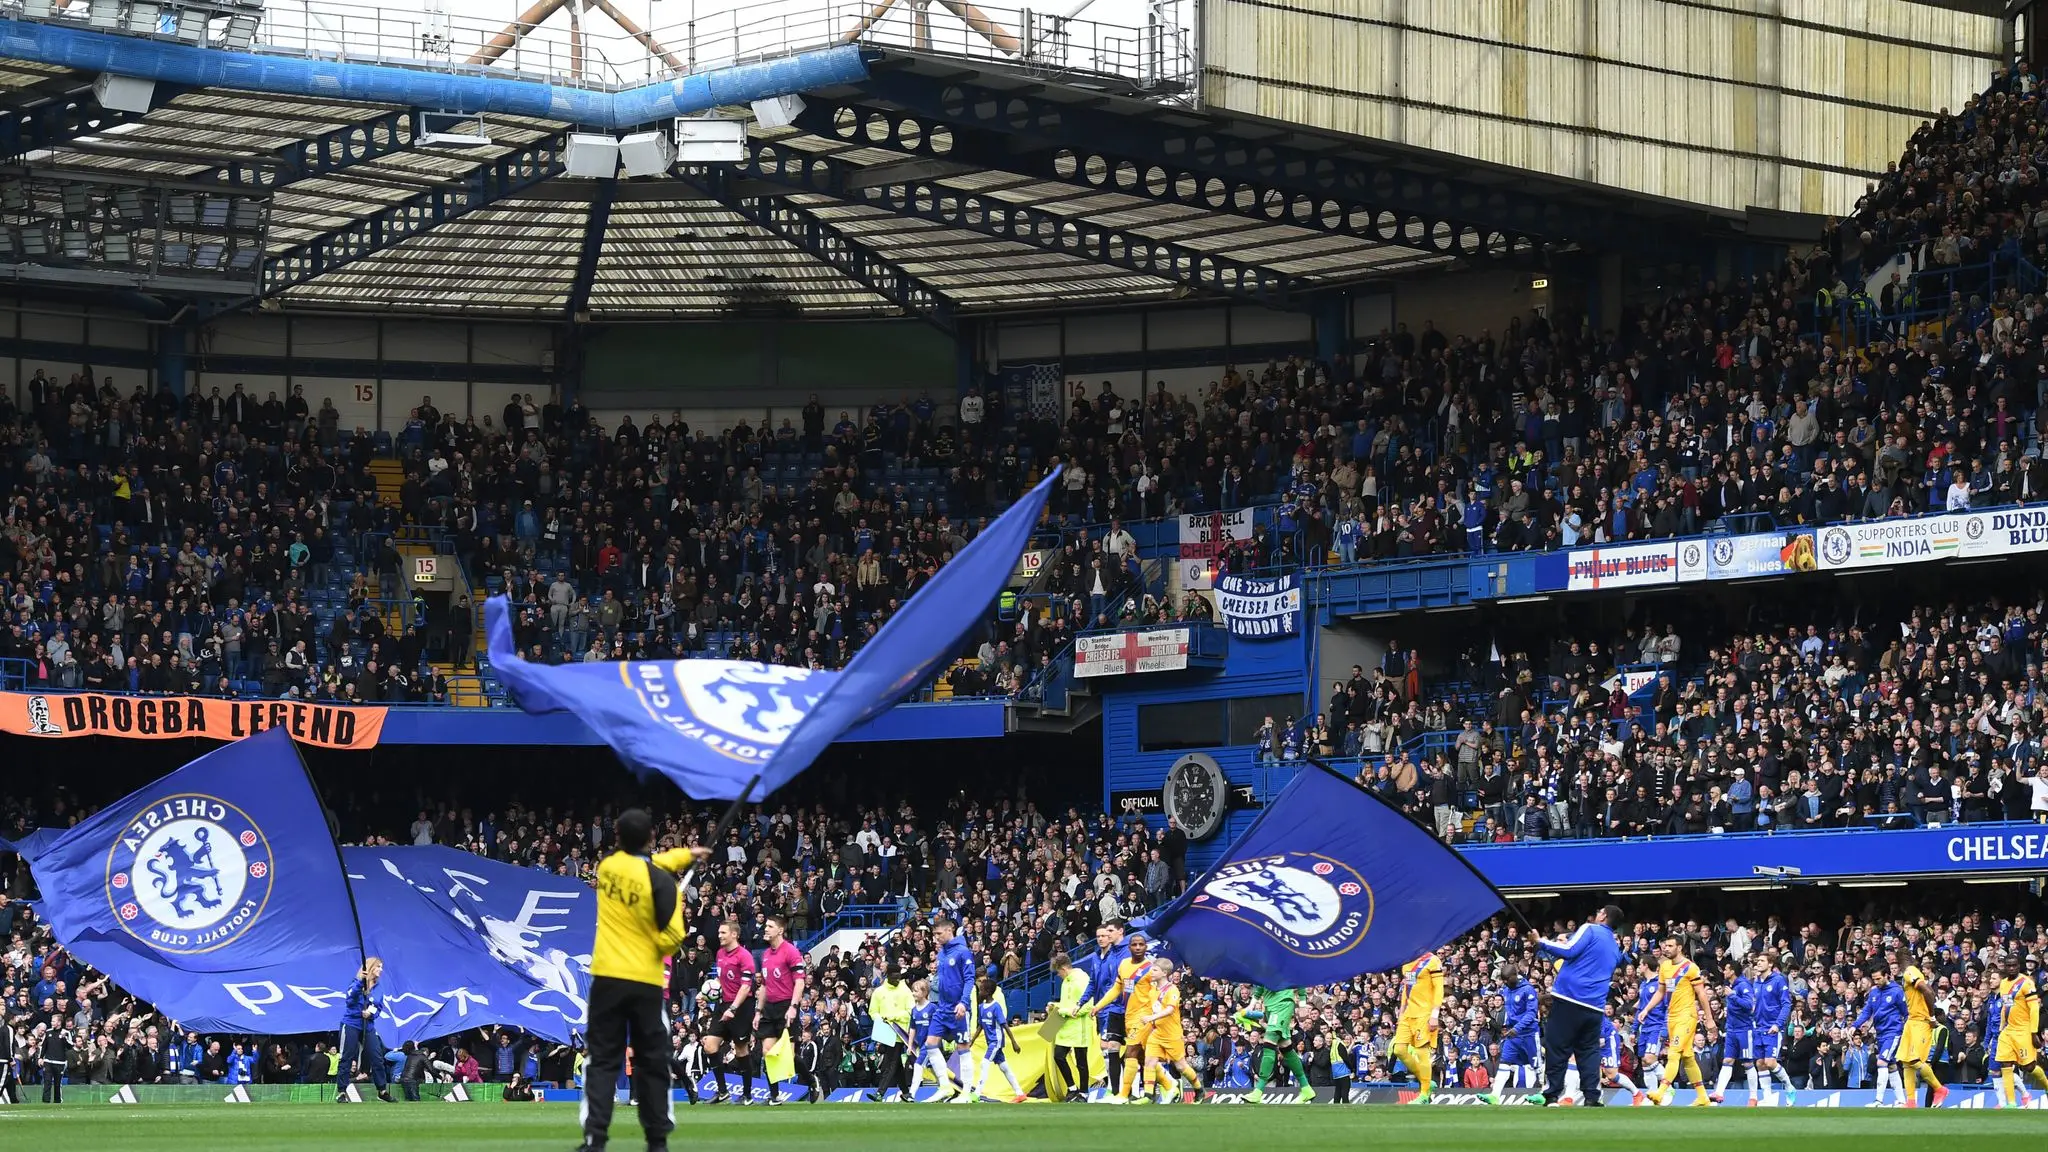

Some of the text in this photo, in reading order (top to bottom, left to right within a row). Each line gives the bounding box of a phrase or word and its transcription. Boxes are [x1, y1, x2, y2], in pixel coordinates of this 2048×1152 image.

[354, 385, 374, 402] 15
[1189, 512, 1245, 528] BRACKNELL
[1992, 511, 2048, 531] DUND
[1200, 528, 1232, 543] BLUES
[1857, 520, 1959, 541] SUPPORTERS CLUB
[2009, 527, 2048, 546] BLU
[1181, 544, 1218, 558] CHEL
[1740, 536, 1787, 552] German
[1886, 538, 1931, 558] INDIA
[418, 560, 433, 573] 15
[1024, 553, 1040, 567] 16
[1574, 553, 1668, 579] PHILLY BLUES
[1747, 560, 1782, 573] Blues
[1222, 575, 1291, 594] ONE TEAM IN
[1222, 595, 1289, 615] CHELSEA FC
[1232, 618, 1279, 635] LONDON
[1085, 649, 1120, 662] CHELSEA FC
[1150, 644, 1179, 656] ENGLAND
[1103, 663, 1124, 673] Blues
[63, 695, 356, 745] DROGBA LEGEND
[1120, 796, 1159, 809] OFFICIAL
[956, 1032, 970, 1043] 24
